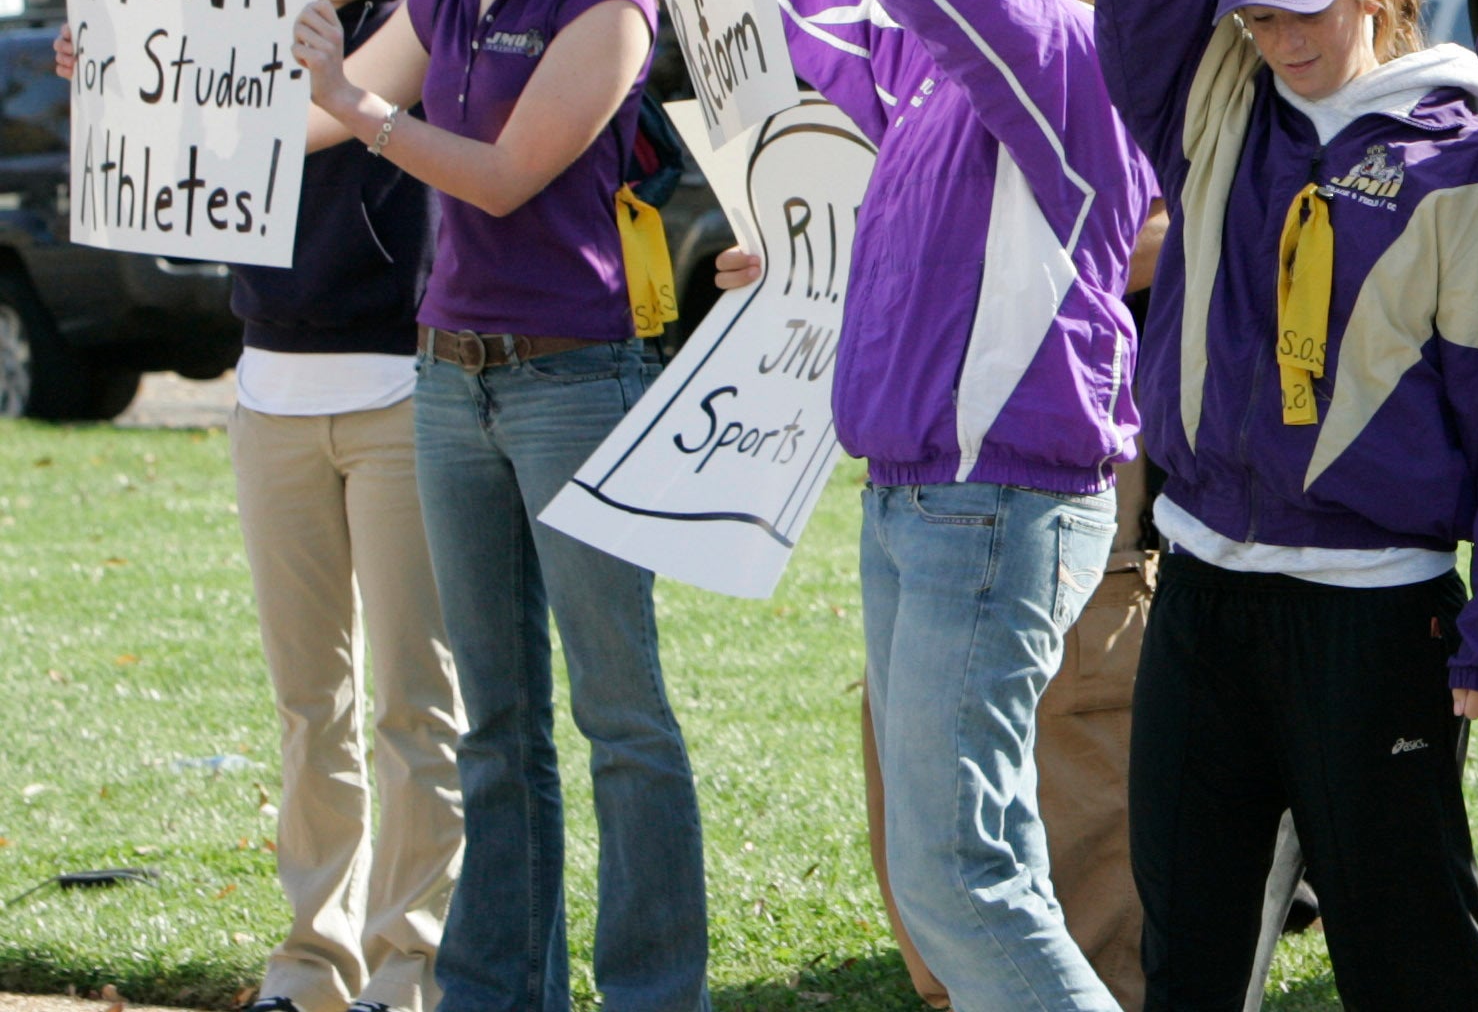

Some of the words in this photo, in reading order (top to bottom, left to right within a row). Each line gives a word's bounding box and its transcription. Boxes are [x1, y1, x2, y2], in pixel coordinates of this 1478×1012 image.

[74, 21, 116, 96] for
[139, 27, 304, 109] Student-
[486, 31, 528, 46] JMU
[80, 124, 283, 238] Athletes!
[1330, 174, 1402, 198] JMU
[783, 197, 862, 304] R.I.
[758, 319, 840, 382] JMU
[673, 386, 805, 474] Sports
